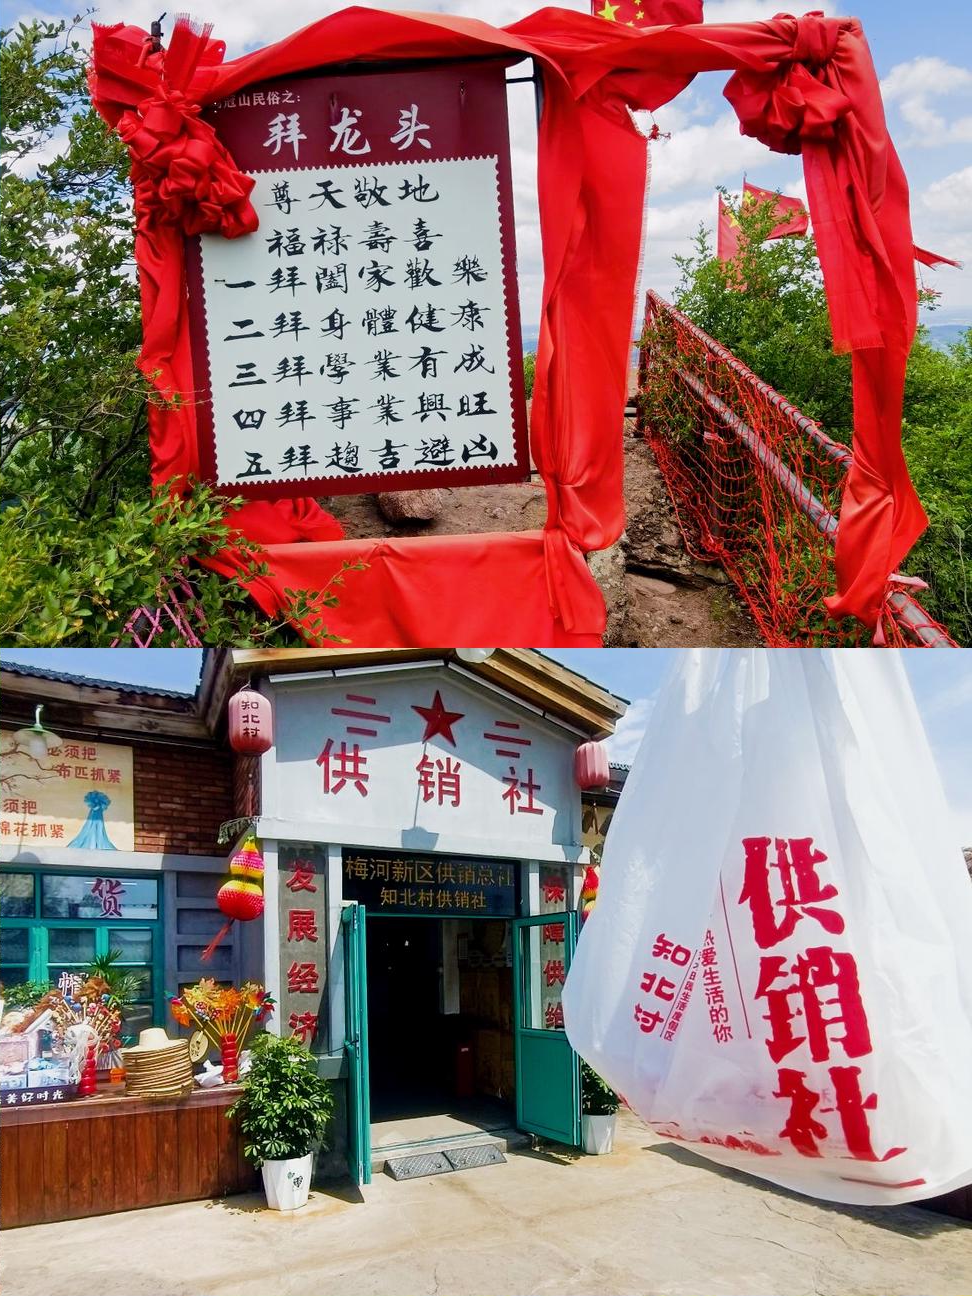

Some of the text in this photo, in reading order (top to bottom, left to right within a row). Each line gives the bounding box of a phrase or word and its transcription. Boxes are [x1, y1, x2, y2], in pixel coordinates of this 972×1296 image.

[262, 103, 433, 160] 拜龙头
[262, 174, 440, 215] 尊天敬地
[223, 299, 491, 344] 二拜身體健康
[228, 343, 495, 387] 三拜學業有成
[232, 391, 498, 431] 四拜事業興旺
[241, 700, 261, 738] 知北村
[56, 763, 122, 784] 布匹抓紧
[316, 738, 544, 816] 供销社
[3, 798, 38, 815] 须把
[345, 855, 515, 888] 梅河新区供销总社
[380, 886, 487, 910] 知北村供销社
[286, 855, 320, 1046] 发展经济
[634, 933, 692, 1034] 知北村
[737, 836, 908, 1166] 供销社
